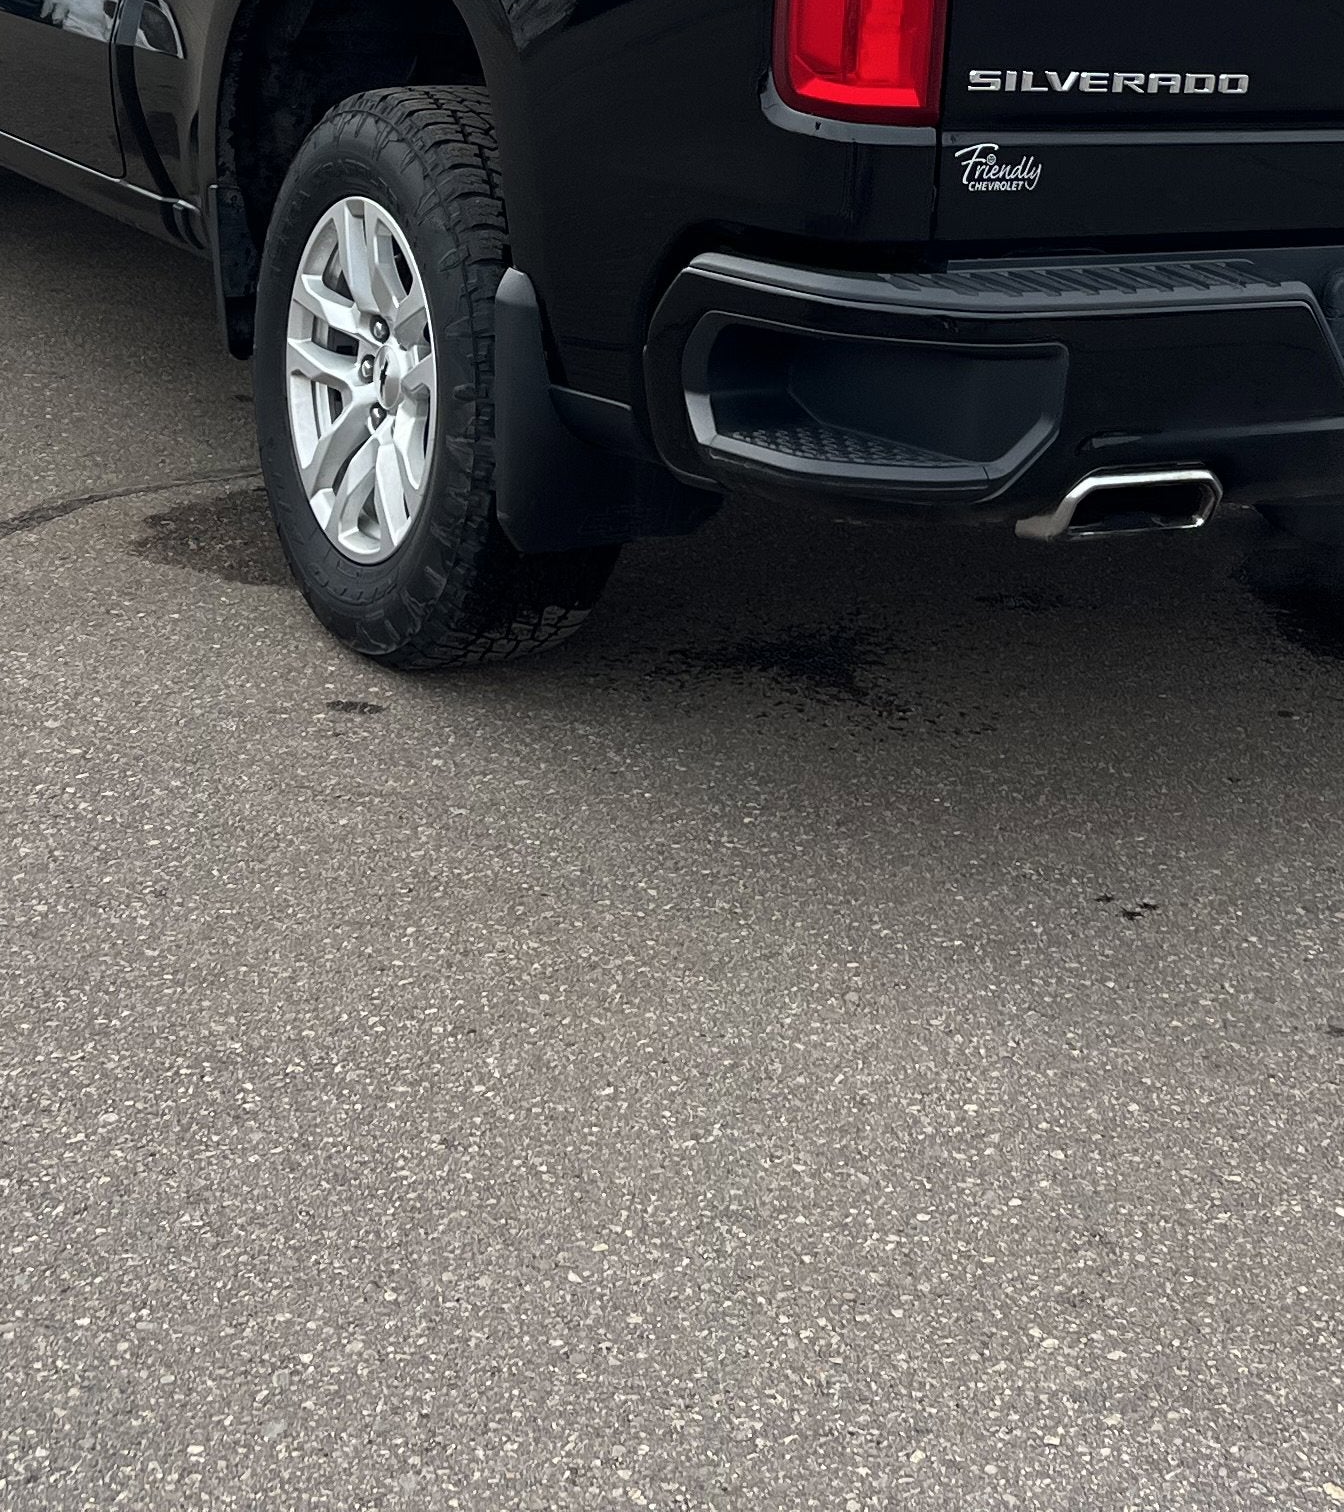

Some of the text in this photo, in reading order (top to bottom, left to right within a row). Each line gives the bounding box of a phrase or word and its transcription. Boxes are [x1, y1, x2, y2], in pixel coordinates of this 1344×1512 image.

[967, 70, 1249, 94] SILVERADO
[955, 143, 1042, 191] Friendly
[968, 181, 1024, 191] CHEVROLET
